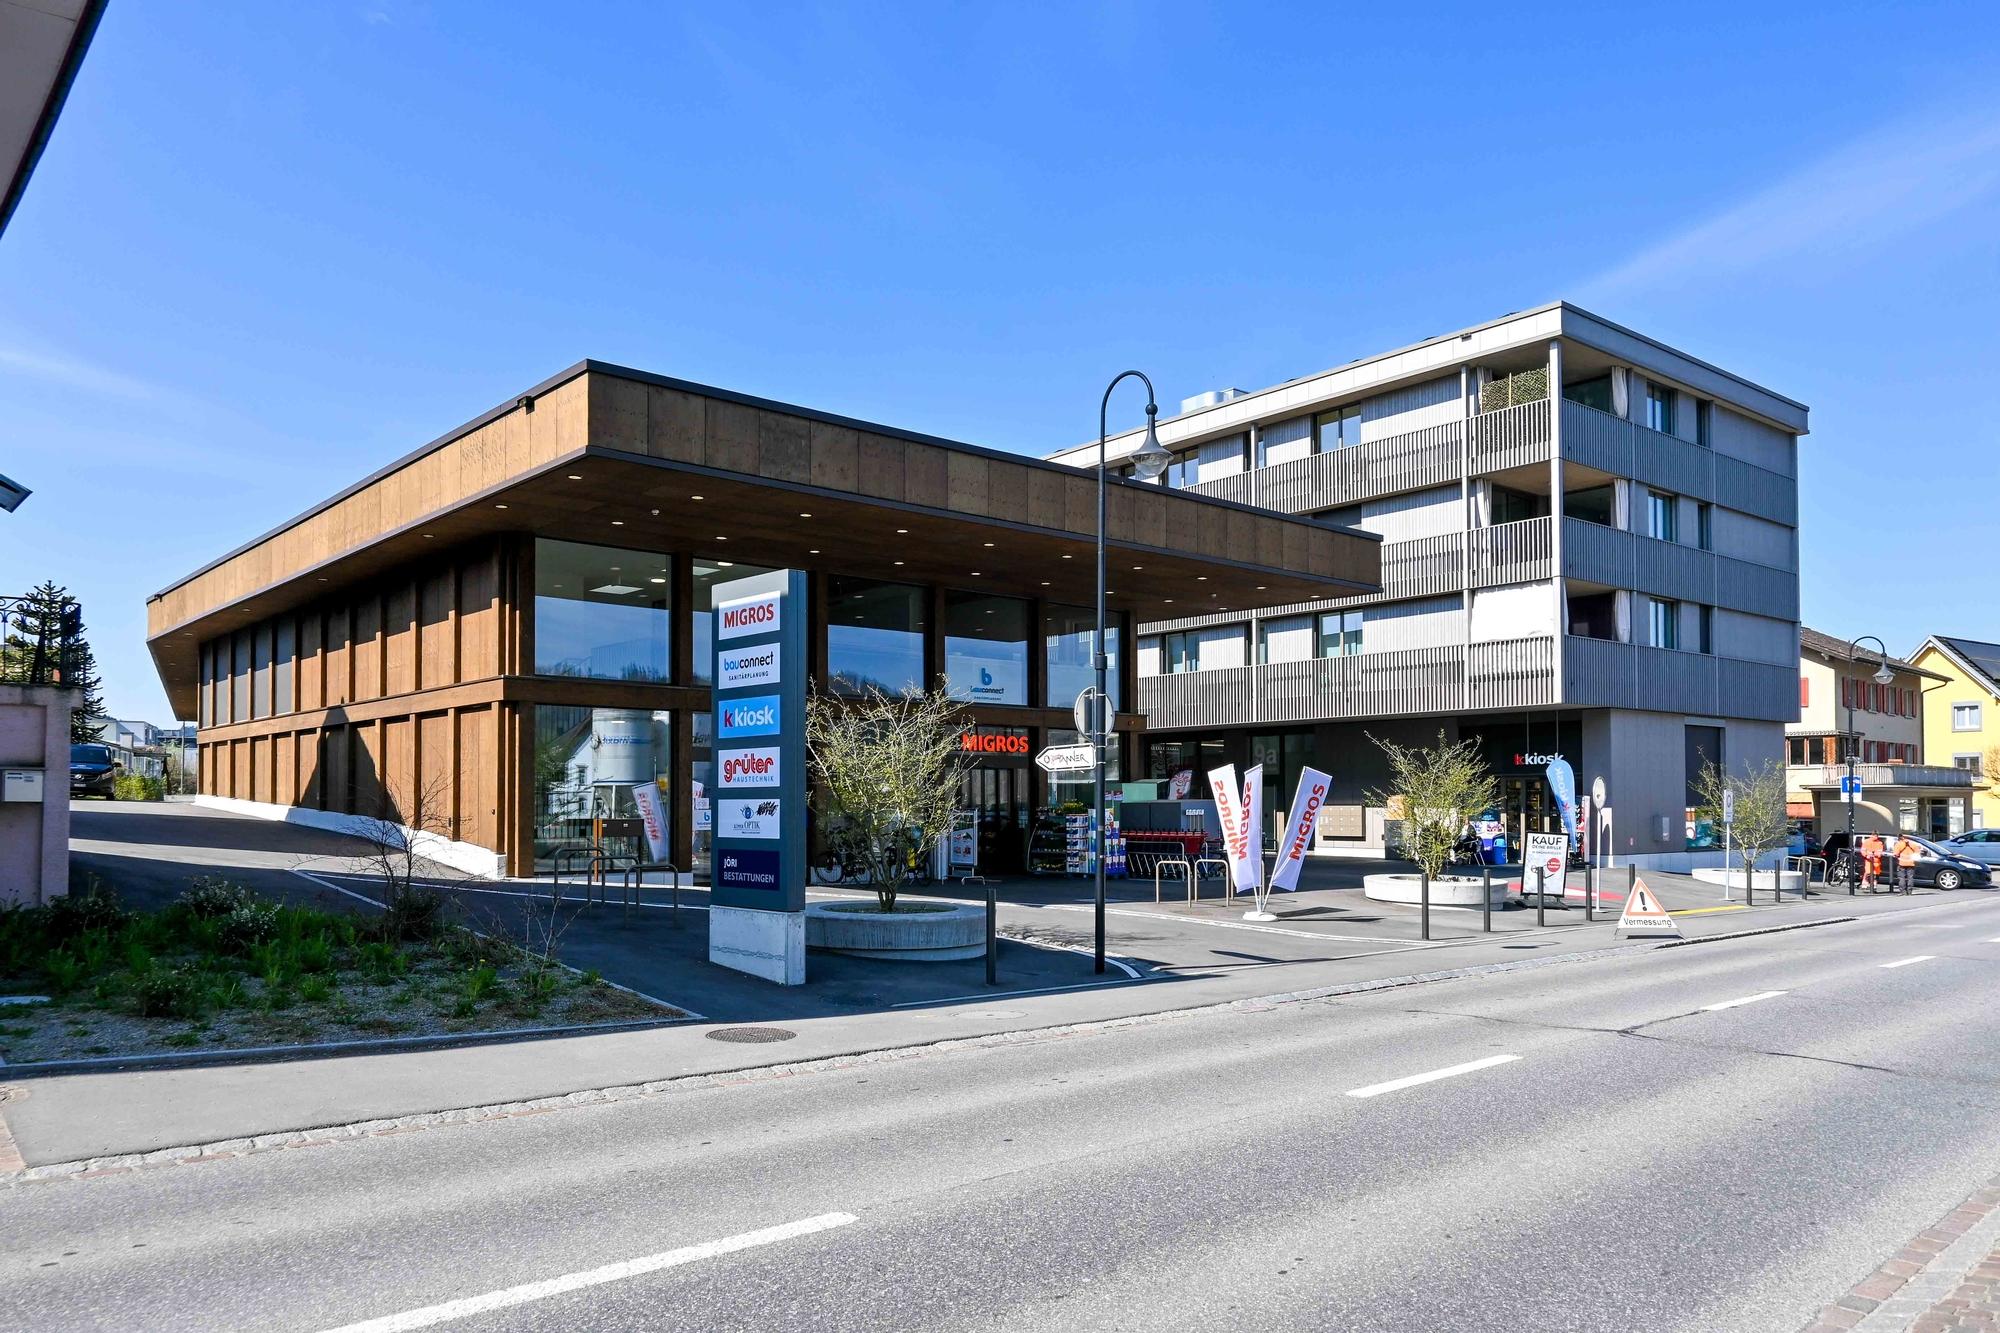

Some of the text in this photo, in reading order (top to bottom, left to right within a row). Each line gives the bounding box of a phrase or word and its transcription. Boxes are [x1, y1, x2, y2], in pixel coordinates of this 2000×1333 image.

[724, 603, 774, 628] MIGROS
[724, 651, 774, 671] bauconnect
[728, 671, 769, 681] SANITÄRPLANUNG
[961, 732, 1029, 753] MIGROS
[724, 753, 774, 783] grüter
[733, 775, 774, 783] HAUSTECHNIK
[744, 820, 760, 829] OPTIK
[1289, 784, 1325, 861] MIGROS
[1532, 836, 1562, 845] KAUF
[723, 856, 738, 868] JÖRI
[723, 871, 775, 884] BESTATTUNGEN
[1623, 918, 1672, 928] Vermessung
